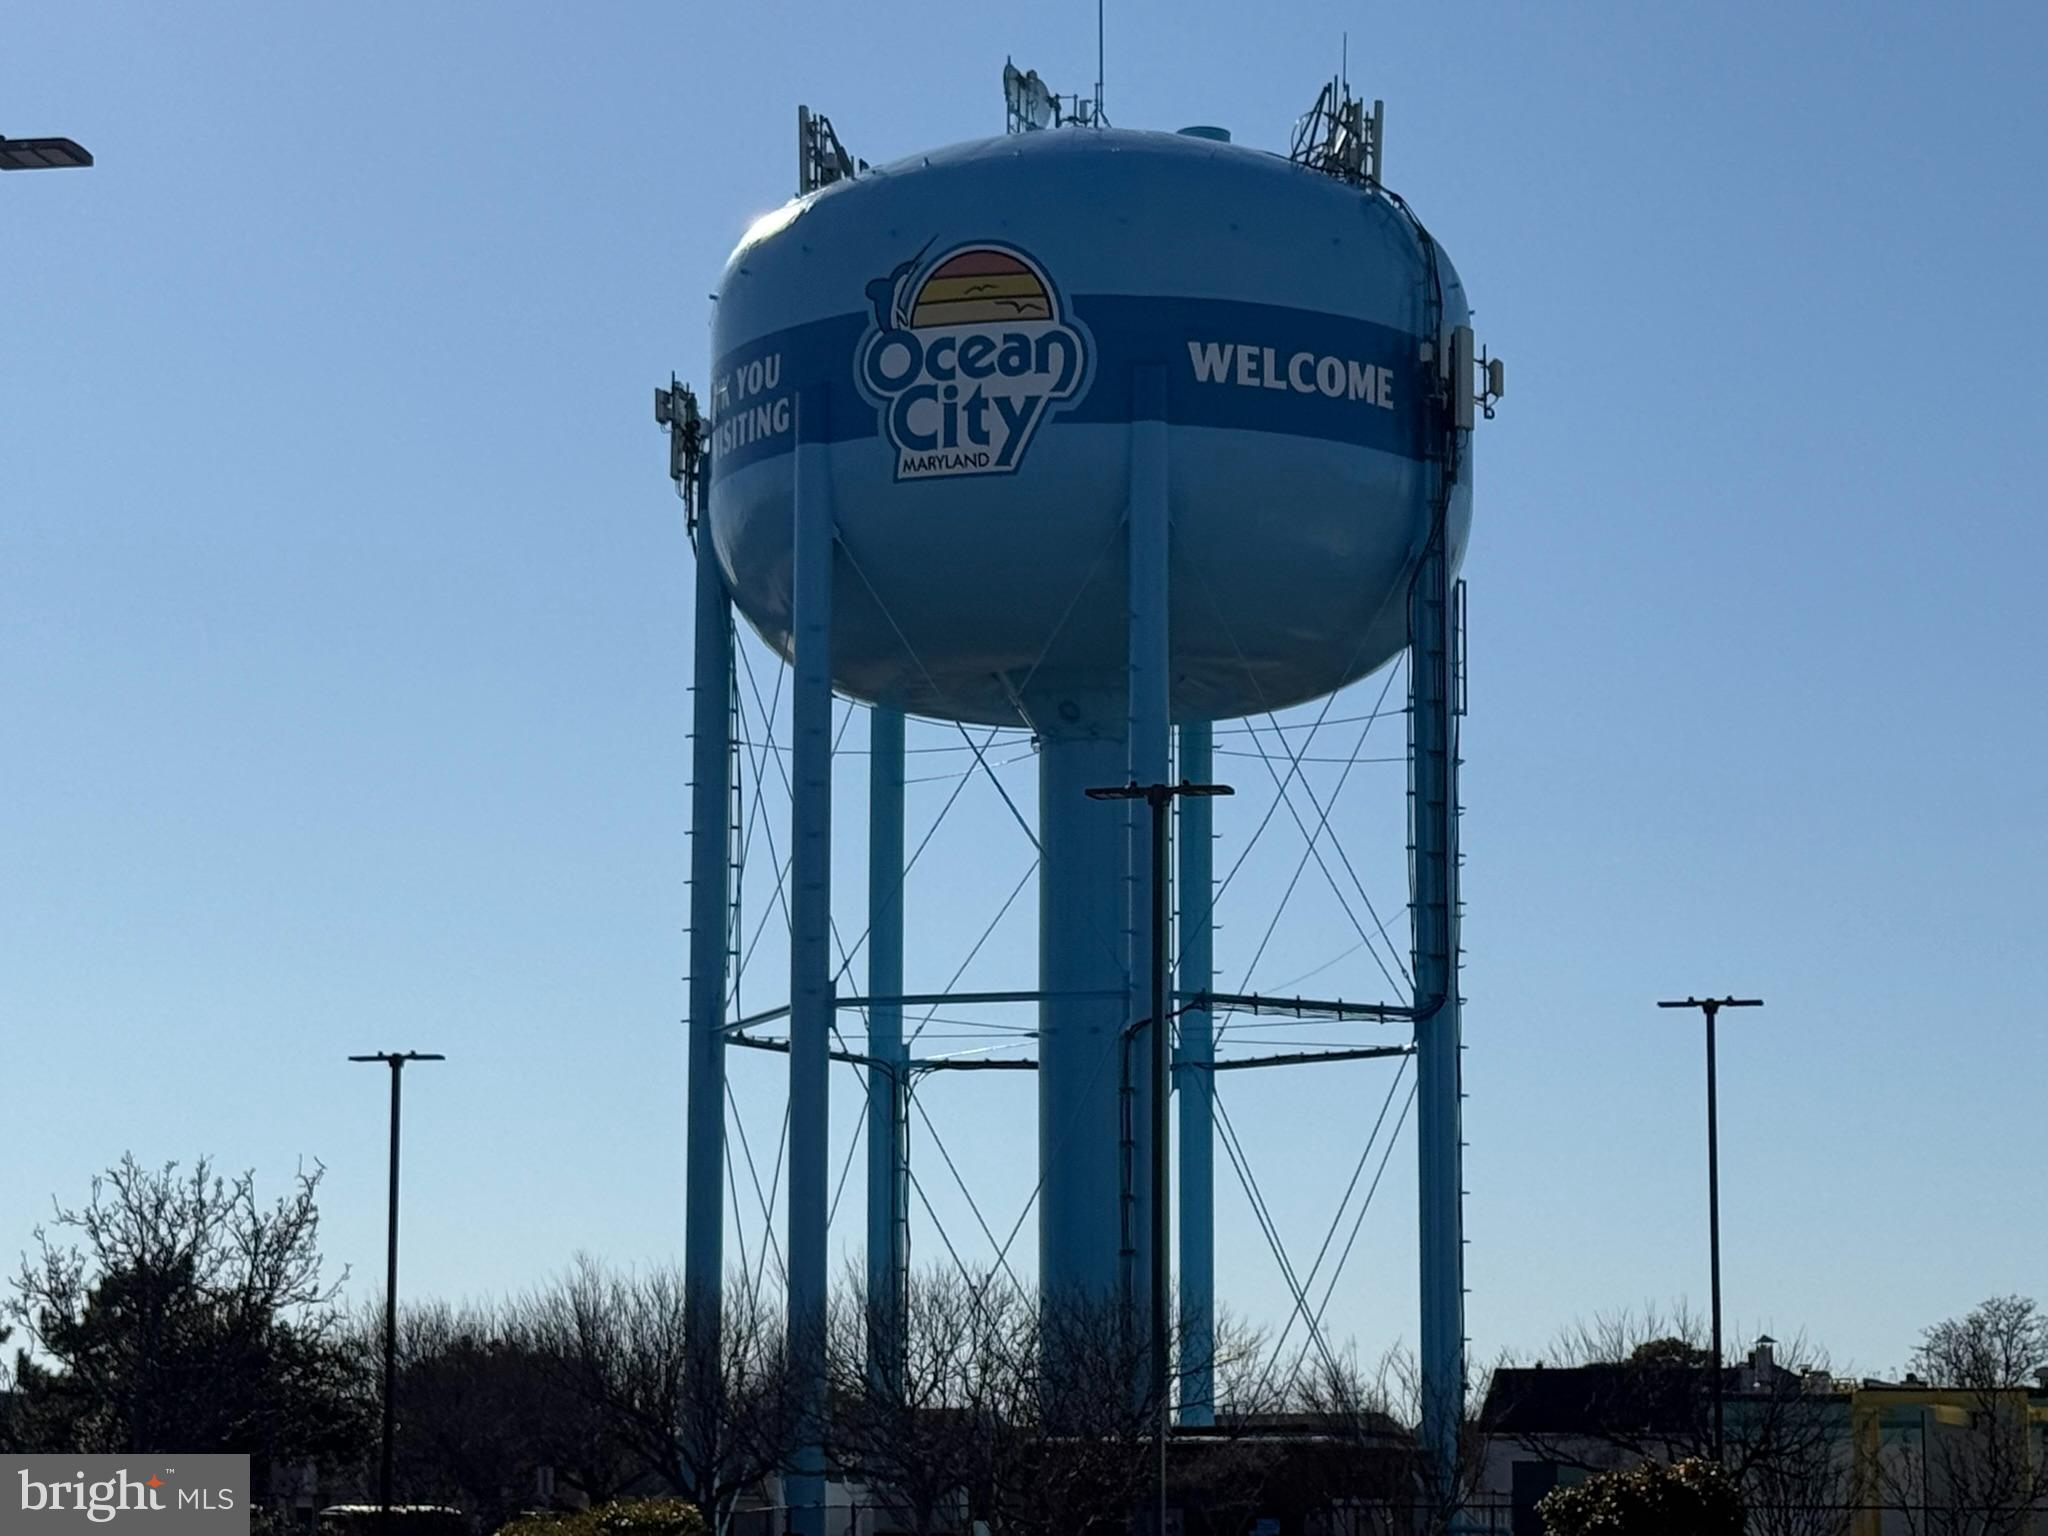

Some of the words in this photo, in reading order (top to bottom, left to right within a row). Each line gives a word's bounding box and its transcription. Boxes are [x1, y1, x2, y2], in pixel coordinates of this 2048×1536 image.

[736, 353, 781, 400] YOU
[867, 329, 1077, 392] Ocean
[1187, 341, 1394, 410] WELCOME
[893, 384, 1042, 467] City
[903, 452, 990, 473] MARYLAND
